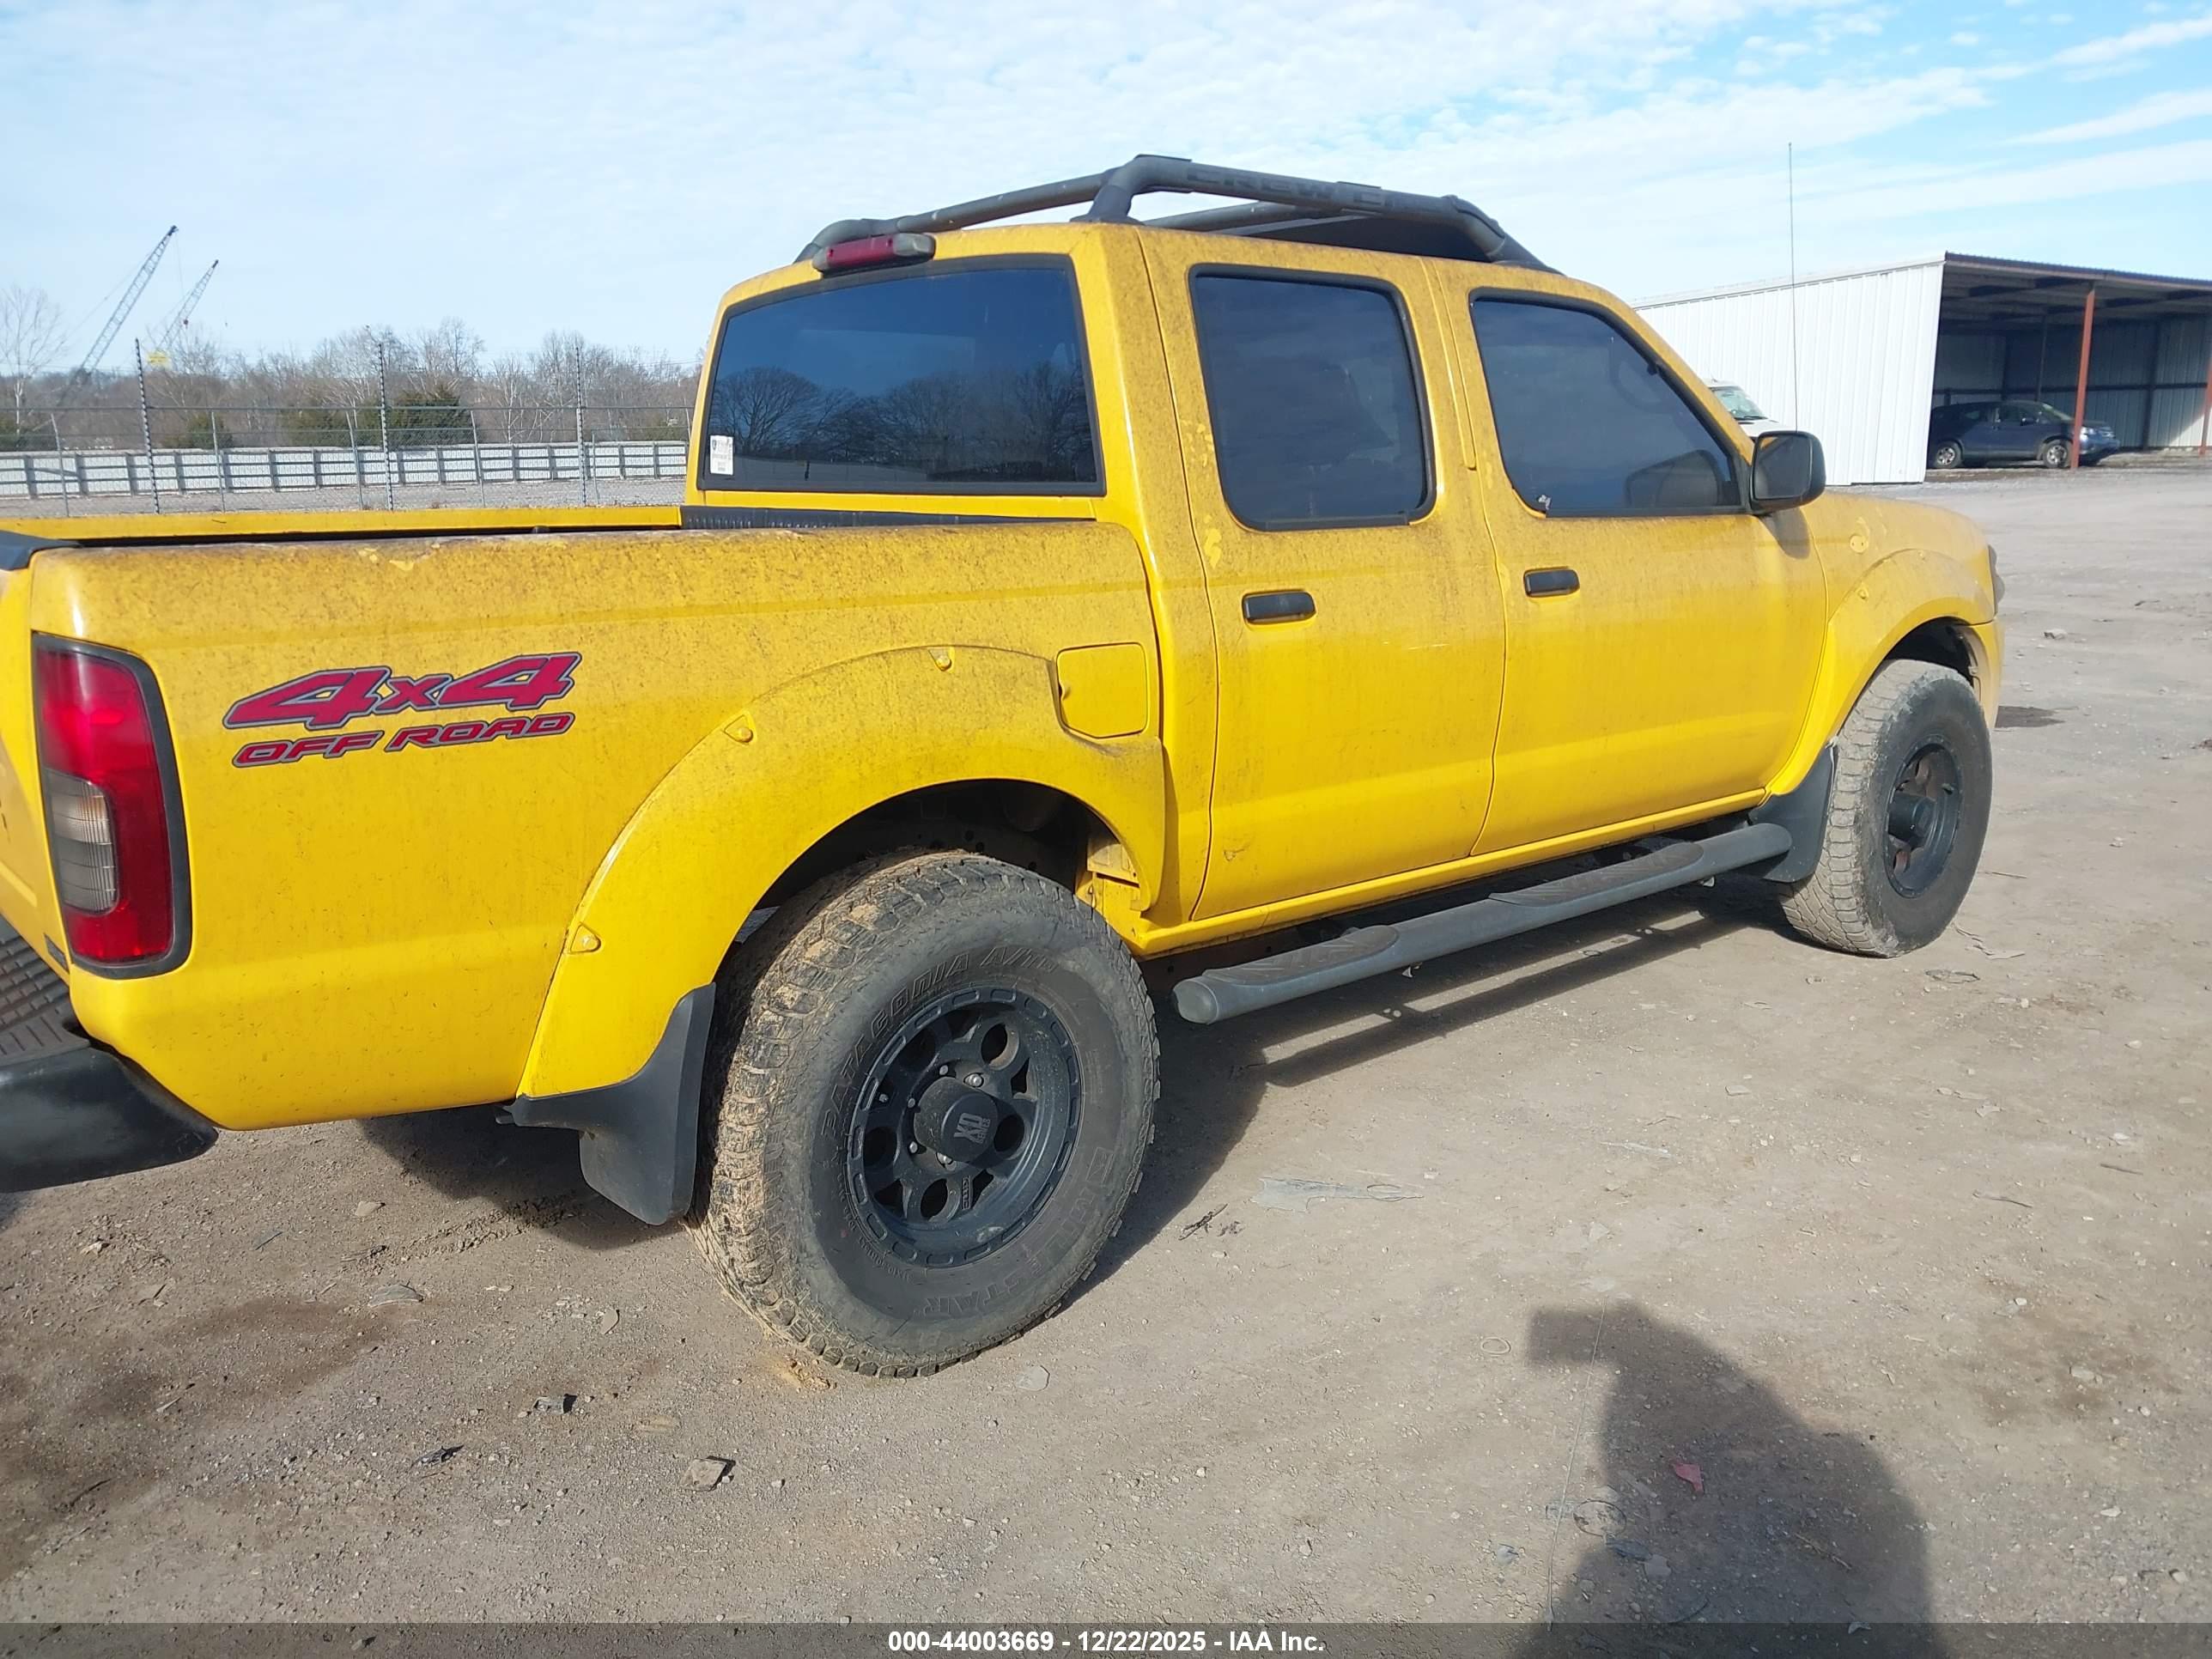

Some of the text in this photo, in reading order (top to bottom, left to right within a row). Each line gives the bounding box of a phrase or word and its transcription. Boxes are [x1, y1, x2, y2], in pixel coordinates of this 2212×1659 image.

[223, 651, 582, 730] 4x4
[232, 712, 575, 768] OFF ROAD
[953, 1112, 985, 1143] XD
